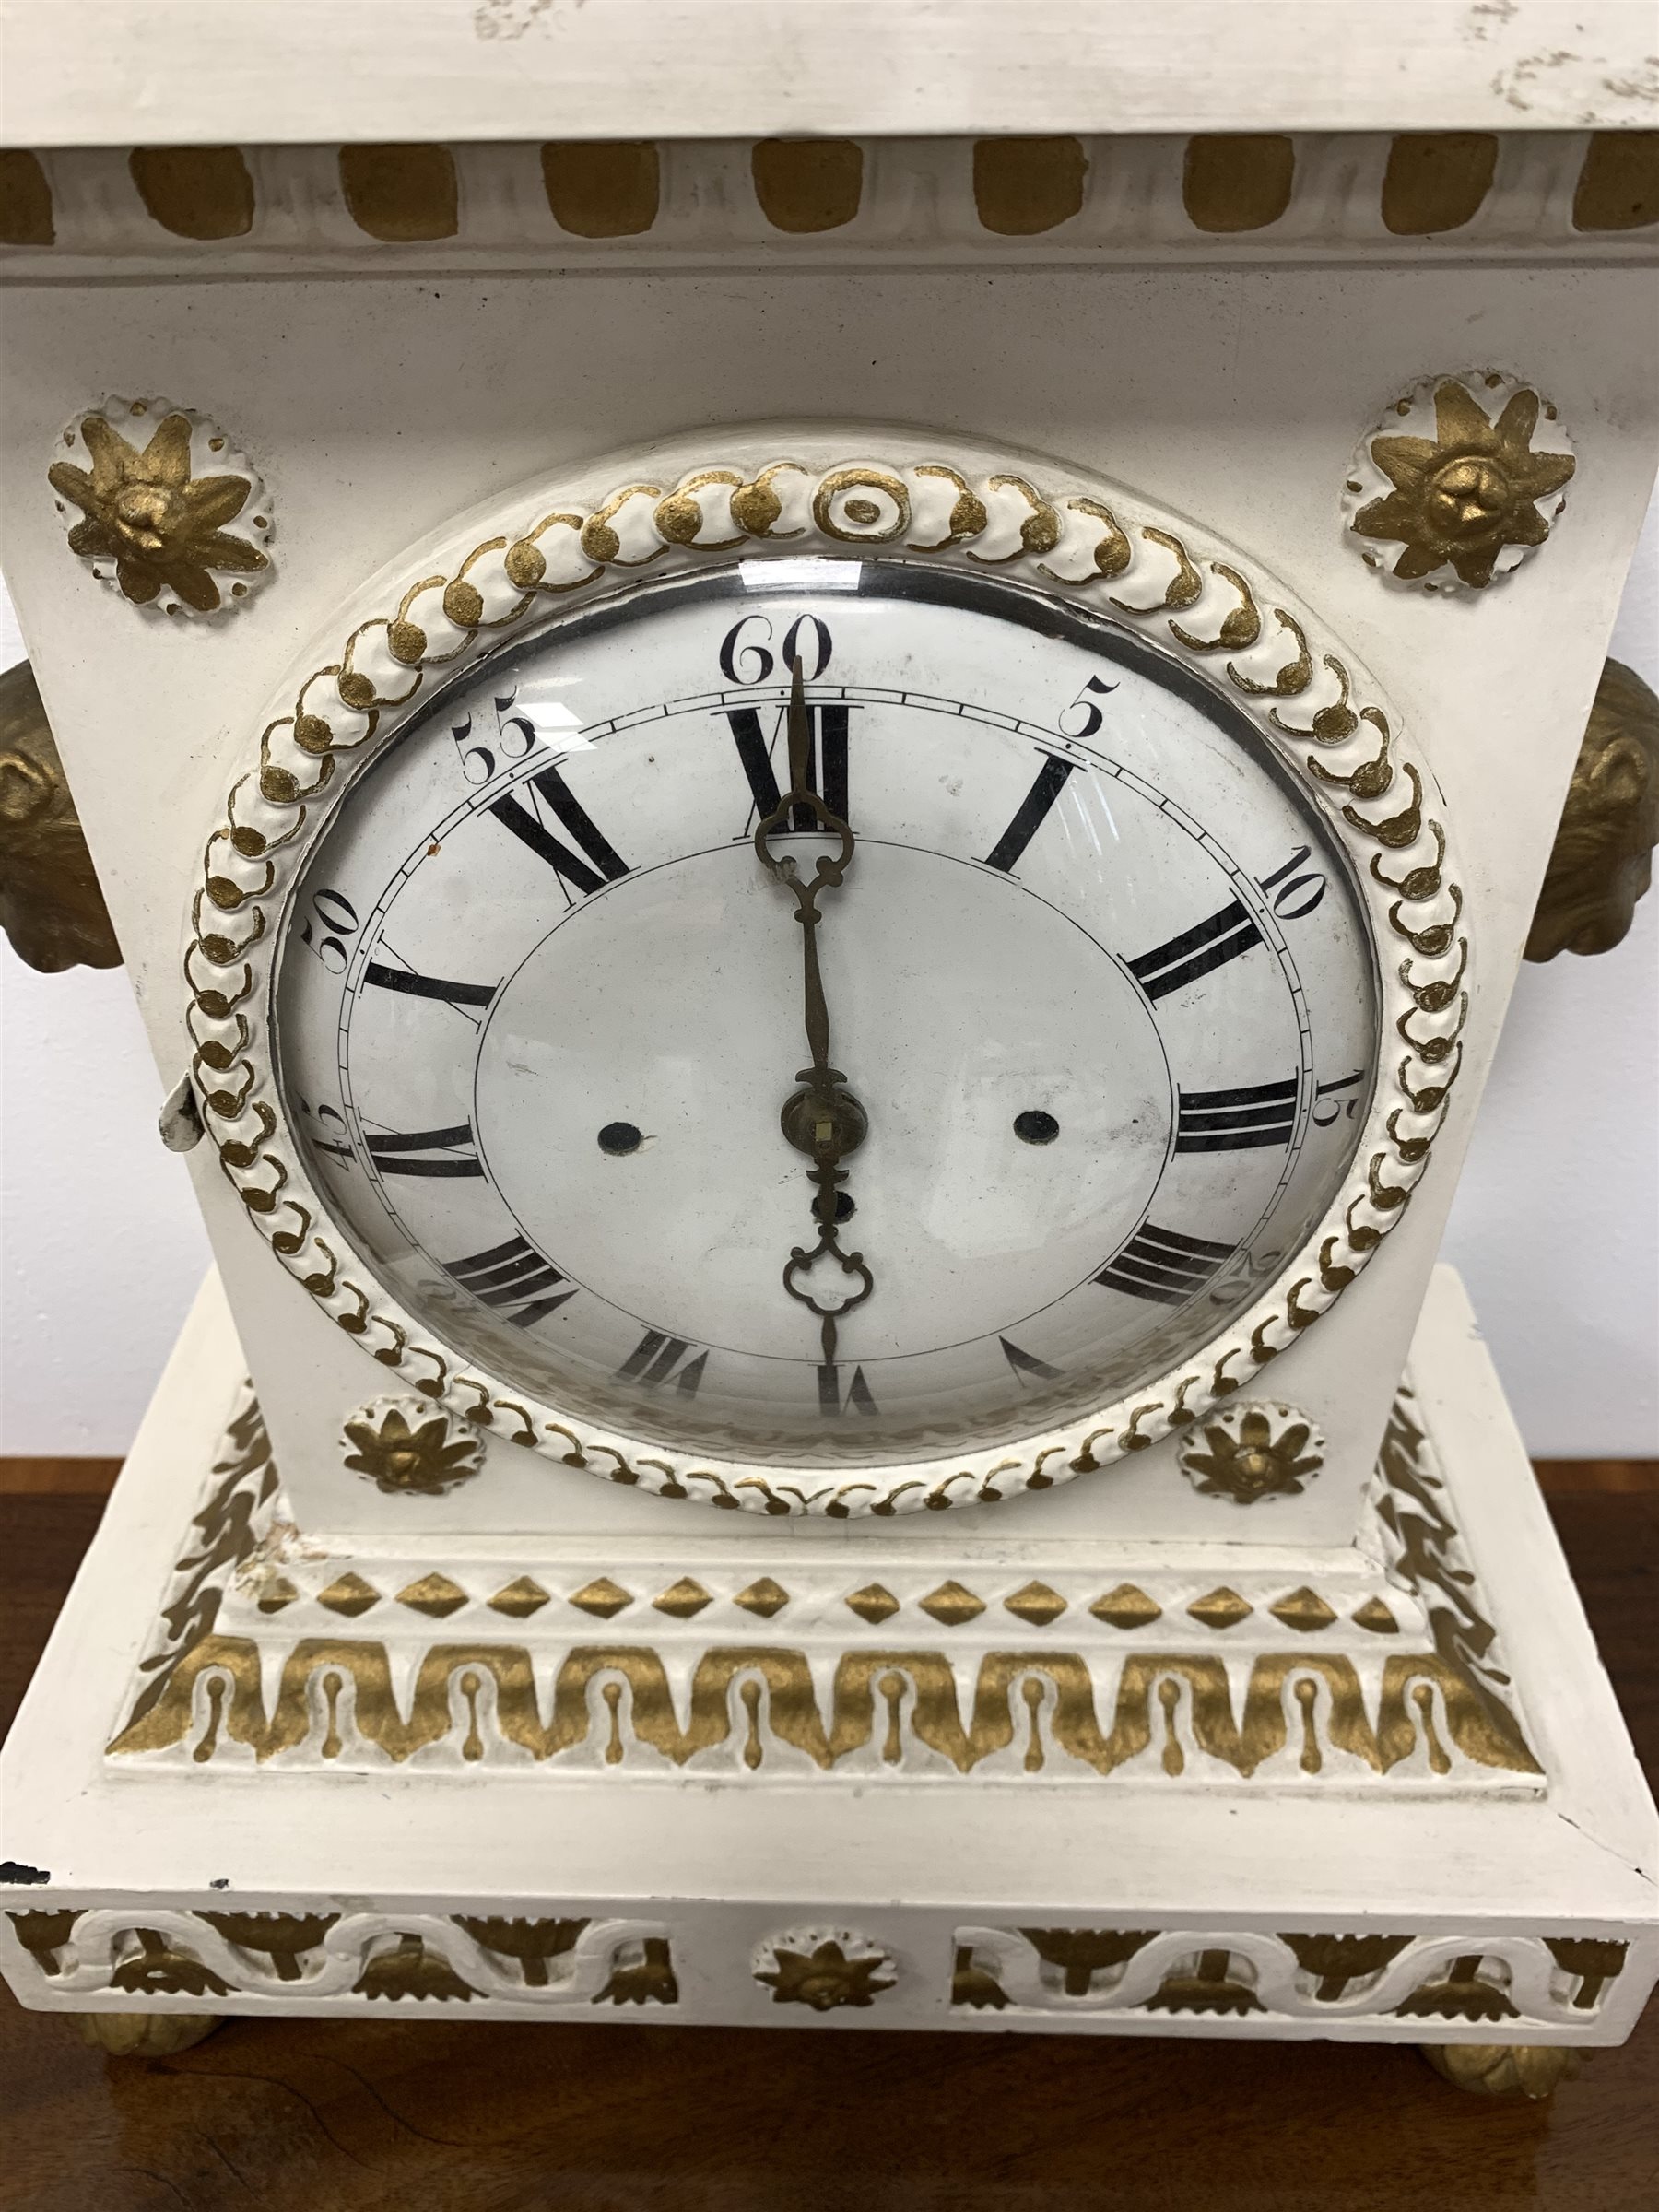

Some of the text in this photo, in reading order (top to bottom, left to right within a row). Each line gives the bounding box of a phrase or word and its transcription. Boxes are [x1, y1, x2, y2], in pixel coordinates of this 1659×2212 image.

[719, 614, 832, 685] 60
[452, 685, 535, 785] 55
[1058, 675, 1120, 737] 5
[711, 705, 865, 841] XII
[971, 747, 1088, 879] I
[477, 759, 642, 913] XI
[1253, 845, 1326, 920] 10
[300, 888, 359, 974] 50
[1117, 887, 1269, 1010] II
[360, 929, 504, 1034] X
[295, 1091, 358, 1172] 45
[358, 1107, 488, 1184] IX
[1171, 1066, 1299, 1162] III
[1312, 1068, 1365, 1127] 15
[434, 1228, 581, 1329] VIII
